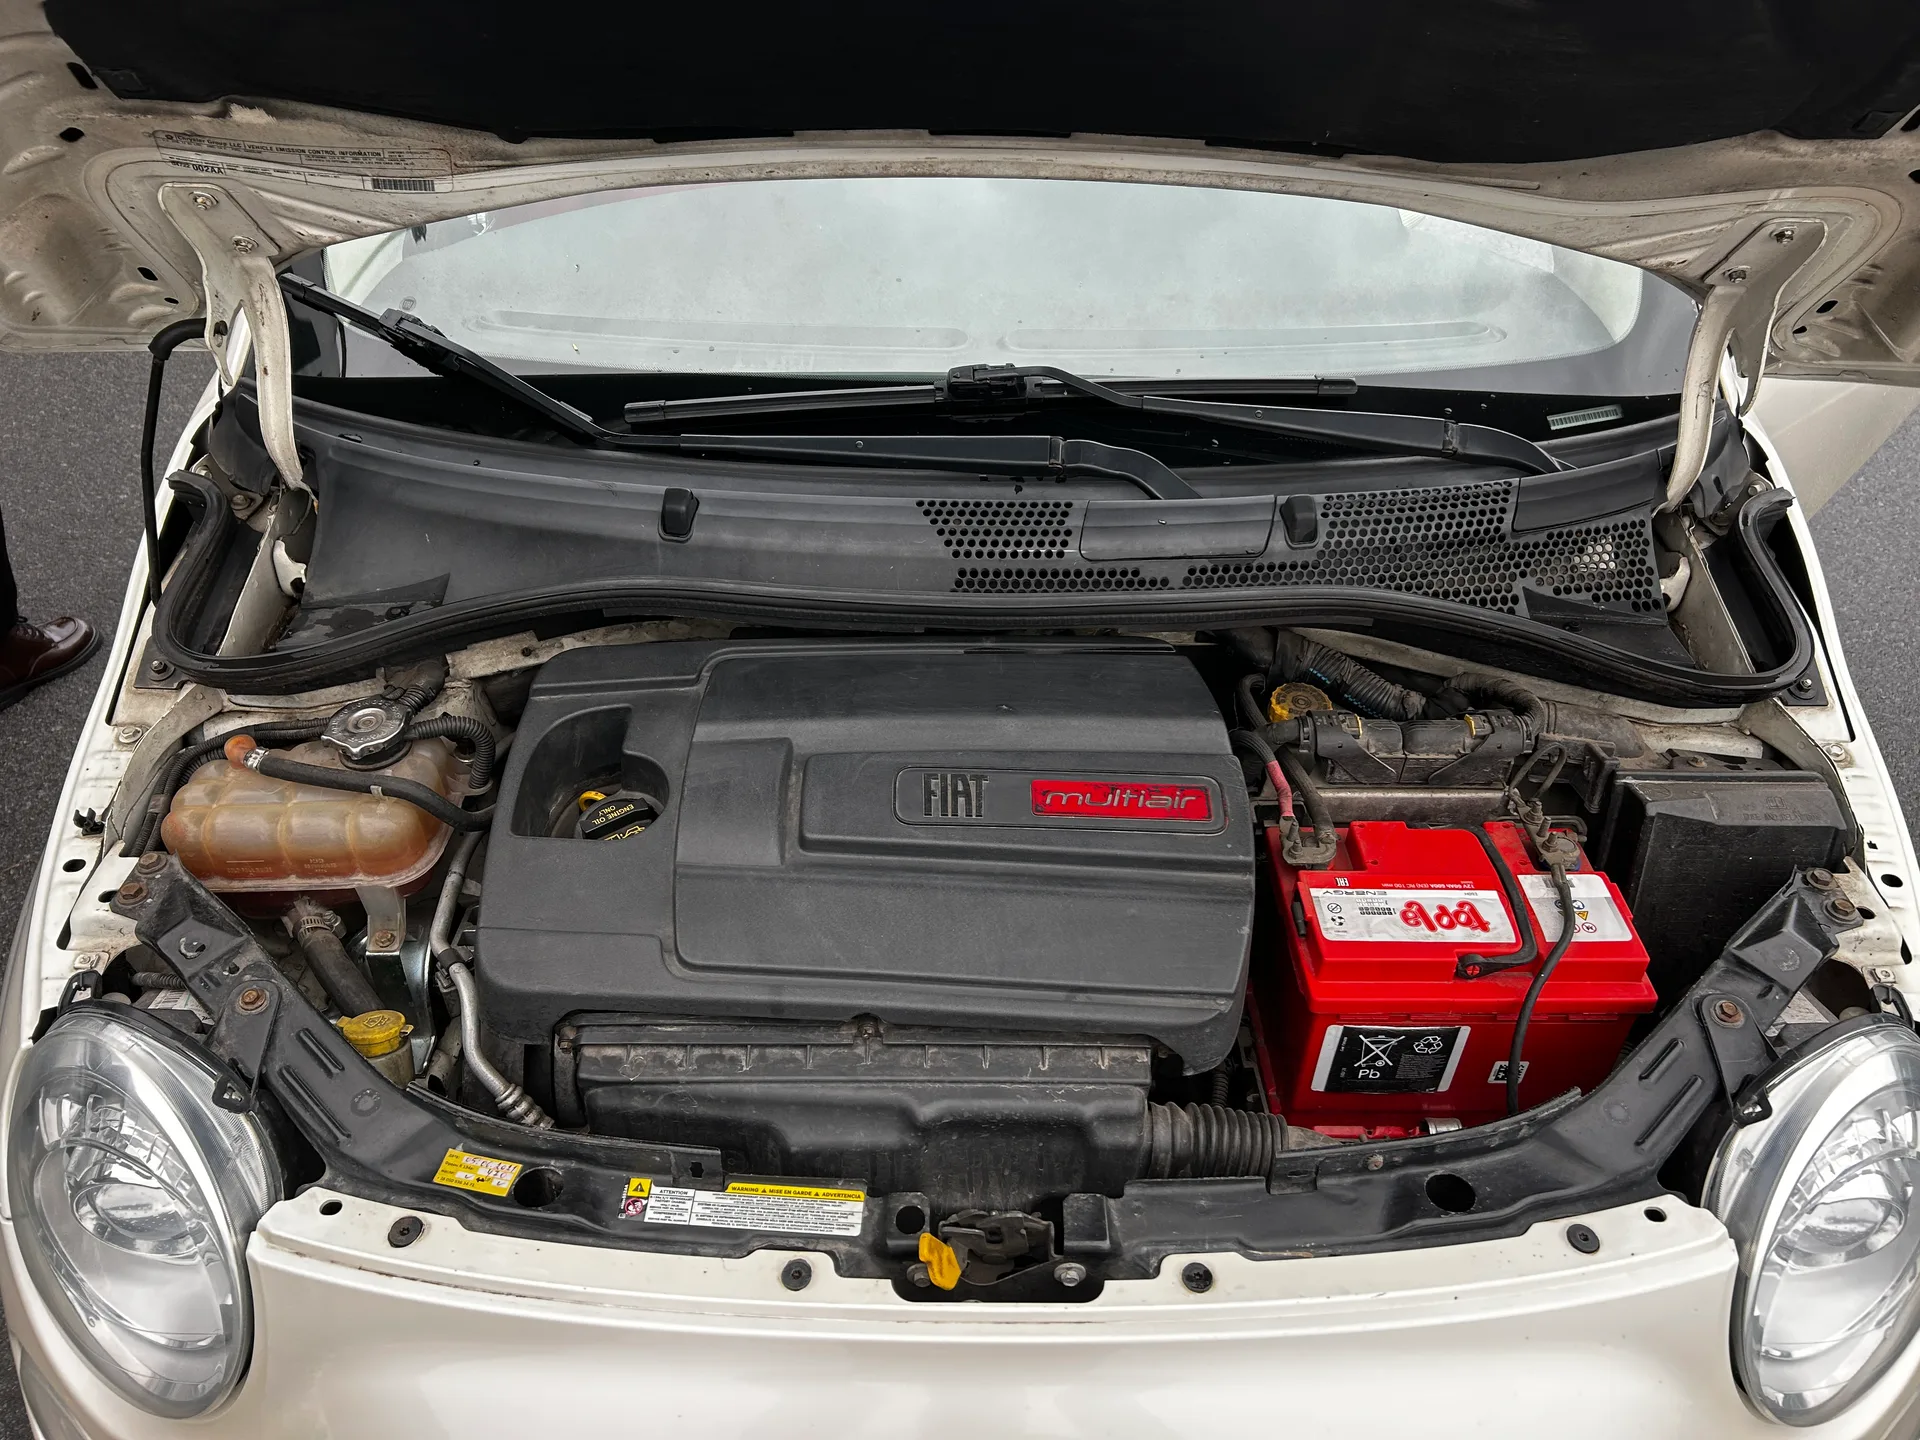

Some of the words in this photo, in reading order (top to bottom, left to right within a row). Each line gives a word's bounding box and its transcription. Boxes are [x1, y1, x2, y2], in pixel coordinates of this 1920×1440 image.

[177, 135, 205, 144] Chrysler
[206, 139, 228, 148] Group
[247, 144, 273, 152] VEHICLE
[275, 146, 306, 154] EMISSION
[192, 165, 224, 175] 002AA
[922, 773, 989, 818] FIAT
[1044, 788, 1197, 810] multiair
[598, 805, 616, 816] ONLY
[606, 803, 635, 820] ENGINE
[591, 816, 606, 825] OIL
[1398, 899, 1491, 934] topla
[1358, 1068, 1380, 1079] Pb
